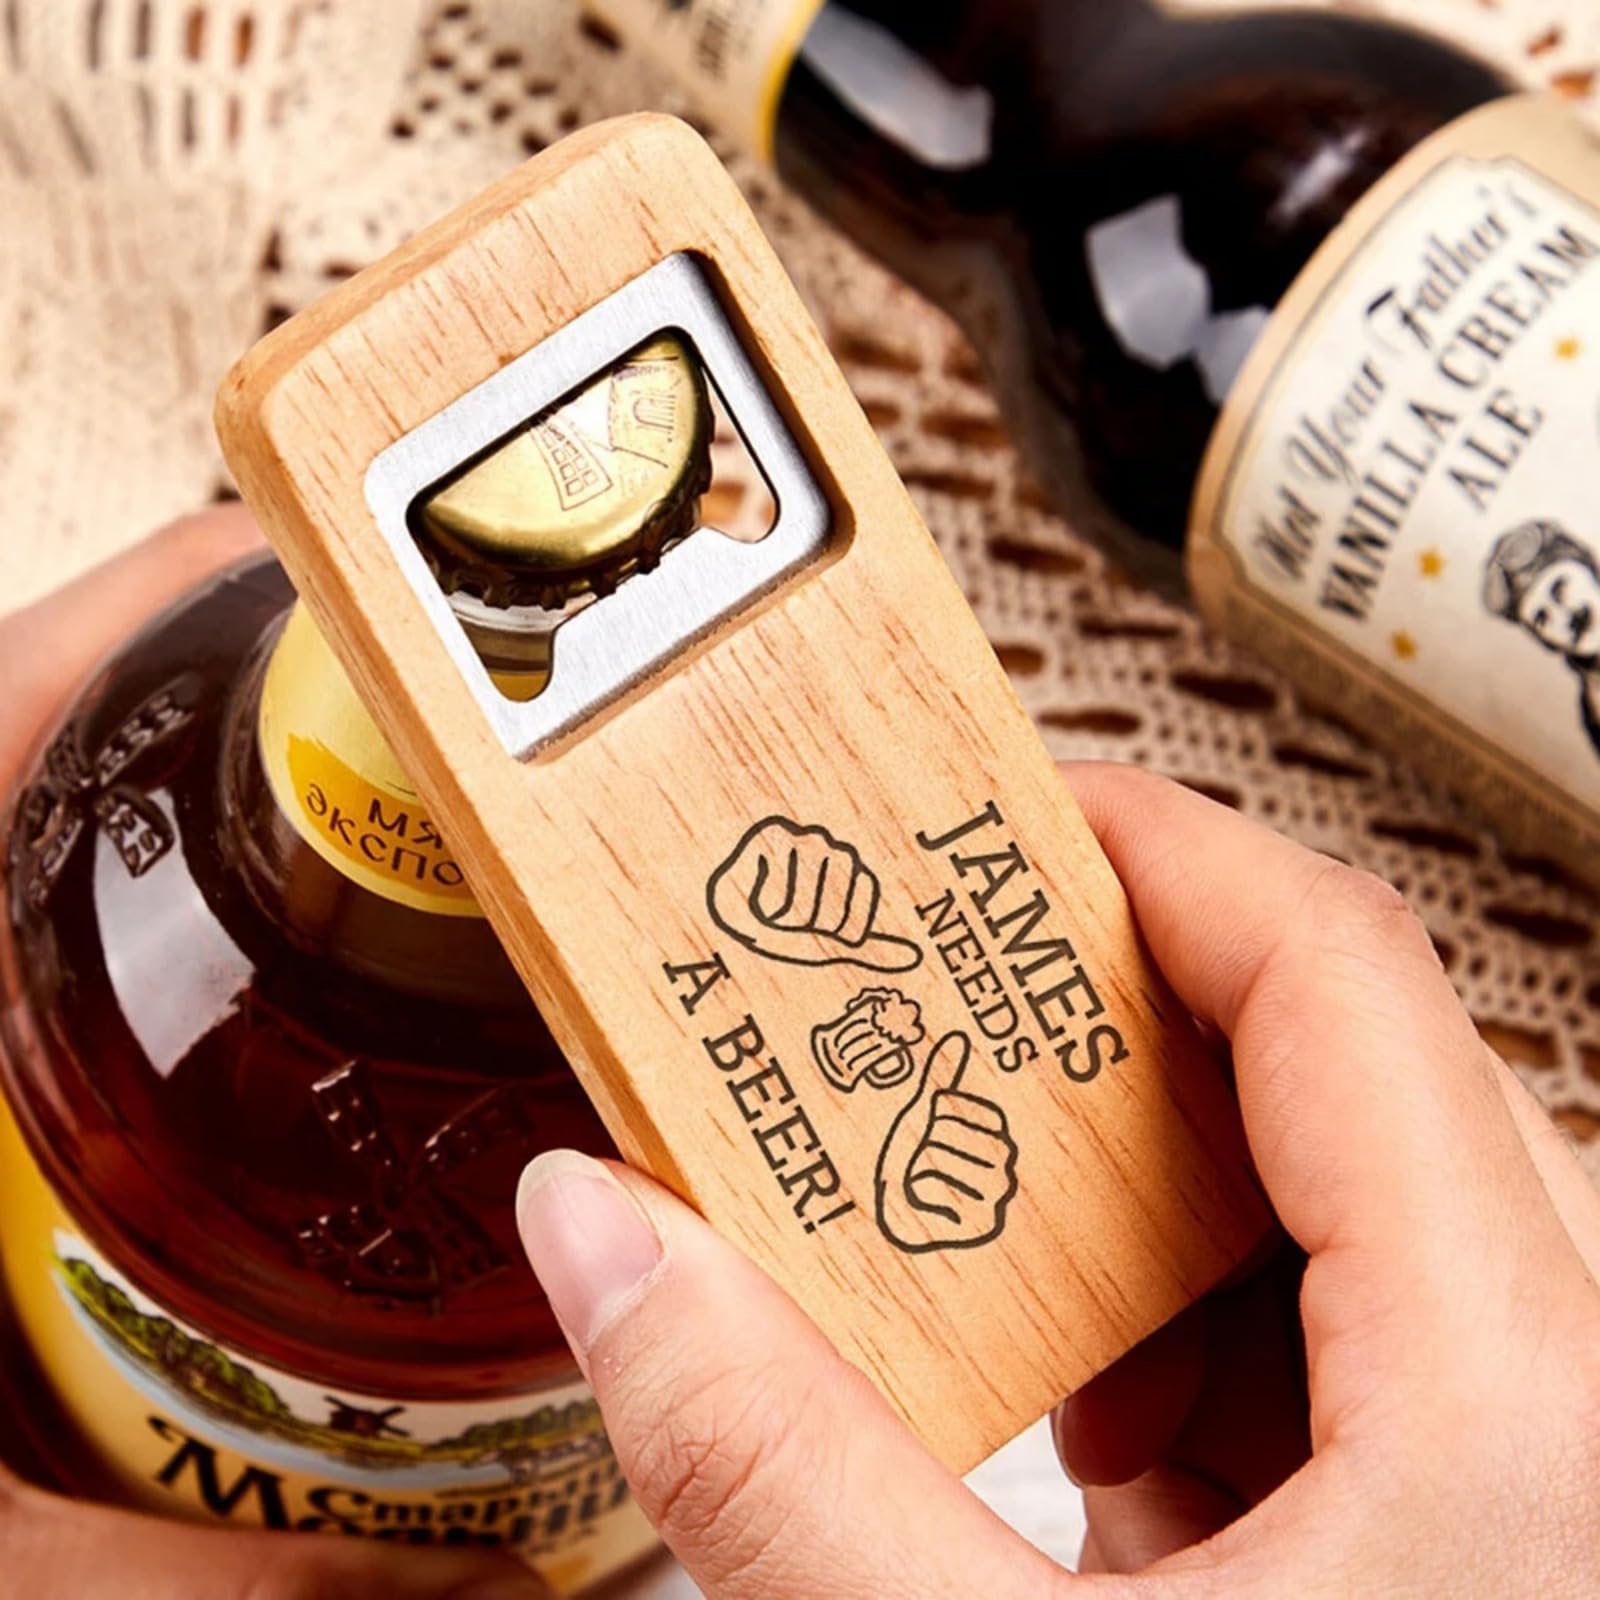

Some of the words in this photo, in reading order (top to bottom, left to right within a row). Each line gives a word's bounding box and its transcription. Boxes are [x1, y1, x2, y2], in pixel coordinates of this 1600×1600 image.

[1365, 180, 1540, 350] Father's
[1283, 360, 1387, 494] Your
[1322, 400, 1458, 622] VANILLA
[1437, 224, 1600, 390] CREAM
[1446, 388, 1545, 512] ALE
[1251, 485, 1323, 584] Not
[914, 888, 1040, 1073] NEEDS
[915, 799, 1131, 1084] JAMES
[661, 952, 731, 1017] A
[701, 1013, 856, 1235] BEER!
